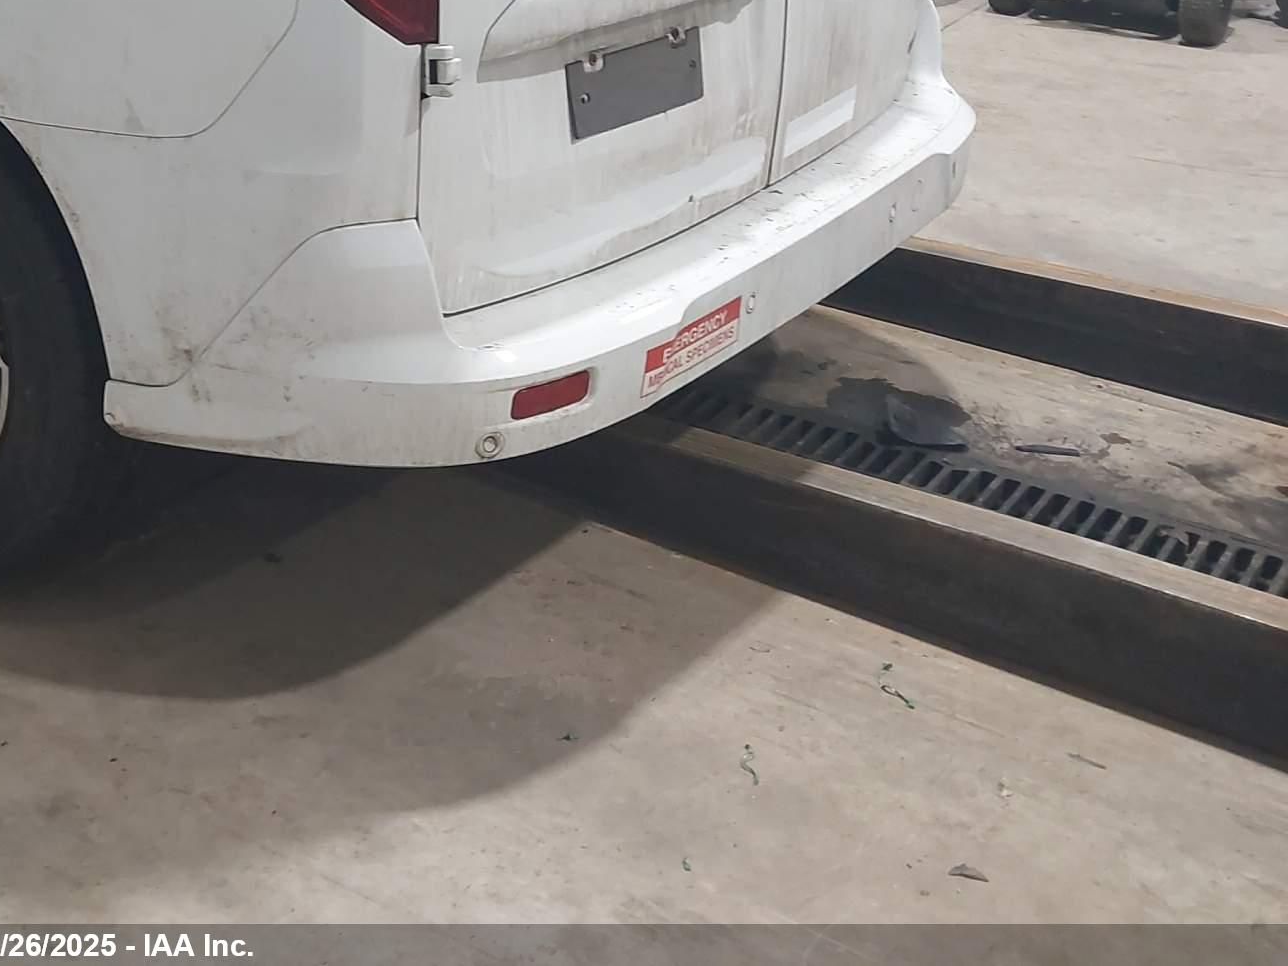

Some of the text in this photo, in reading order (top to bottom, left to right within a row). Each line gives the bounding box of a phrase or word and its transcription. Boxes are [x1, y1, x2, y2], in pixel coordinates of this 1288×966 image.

[648, 325, 735, 388] MEICAL SPECIMENS
[663, 310, 728, 363] EERGENCY
